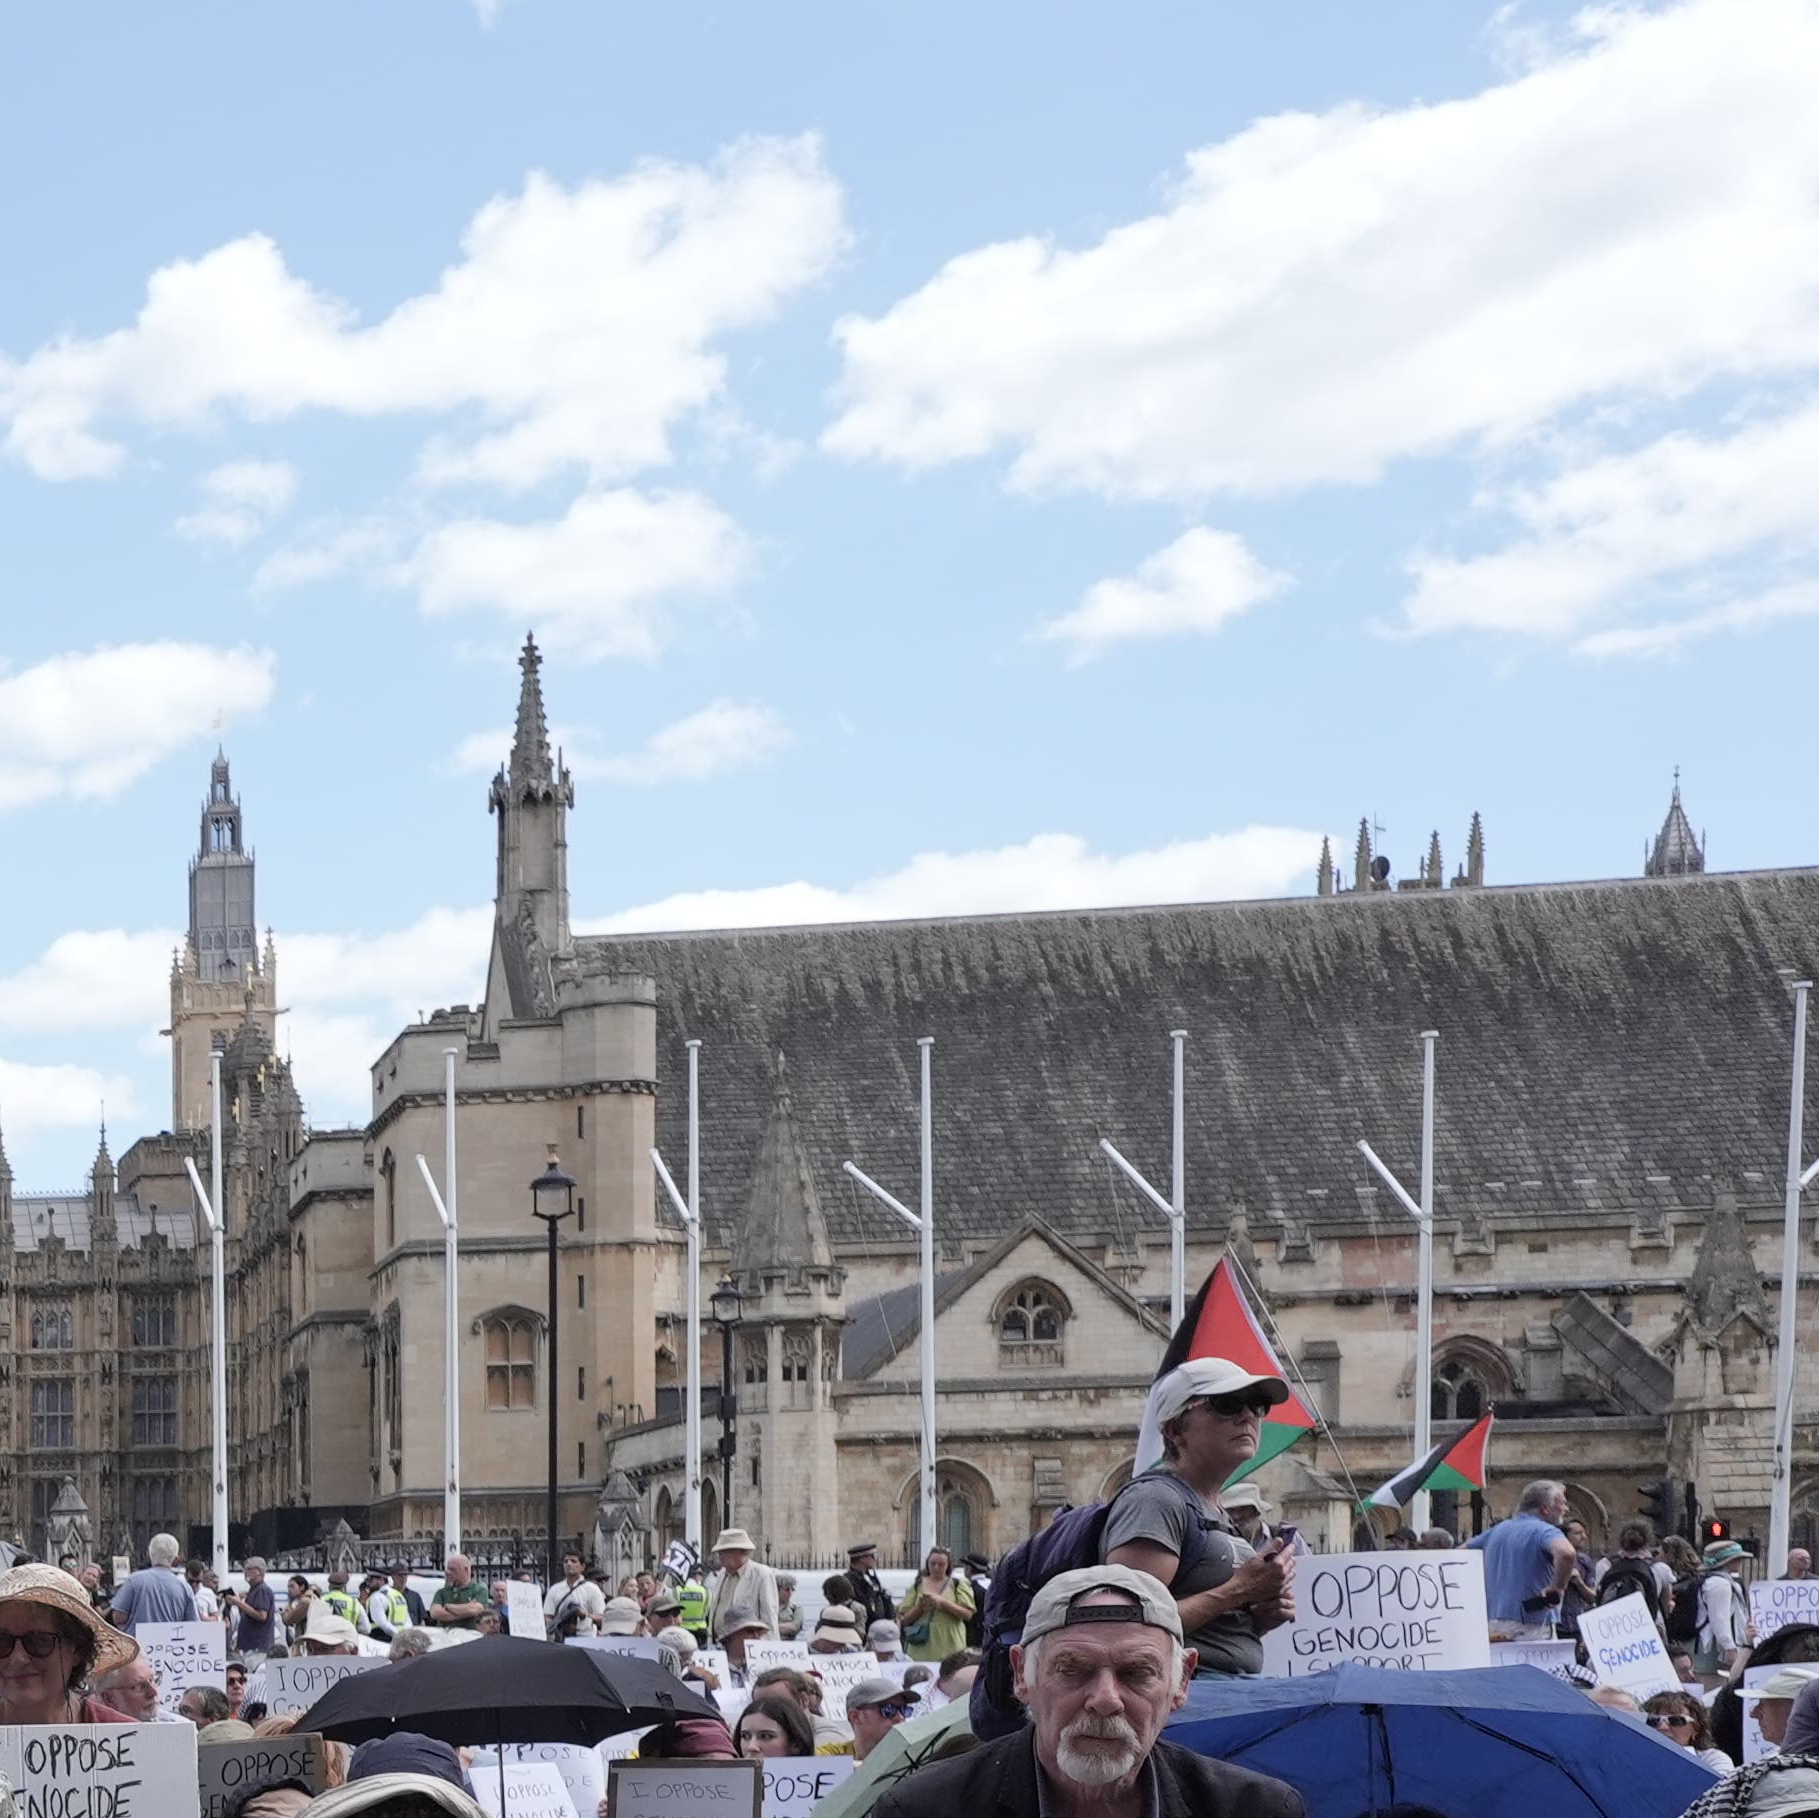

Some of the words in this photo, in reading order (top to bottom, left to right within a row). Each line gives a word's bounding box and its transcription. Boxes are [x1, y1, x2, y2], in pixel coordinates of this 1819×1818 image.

[1312, 1562, 1468, 1619] OPPOSE
[1752, 1588, 1762, 1609] I
[170, 1625, 187, 1642] I
[1292, 1616, 1443, 1656] GENOCIDE
[1598, 1608, 1647, 1638] OPPOSE
[746, 1644, 757, 1659] I
[1599, 1638, 1661, 1675] GENOCIDE
[276, 1664, 287, 1691] I
[23, 1730, 139, 1779] OPPOSE
[626, 1781, 649, 1800] I
[656, 1781, 736, 1801] OPPOSE
